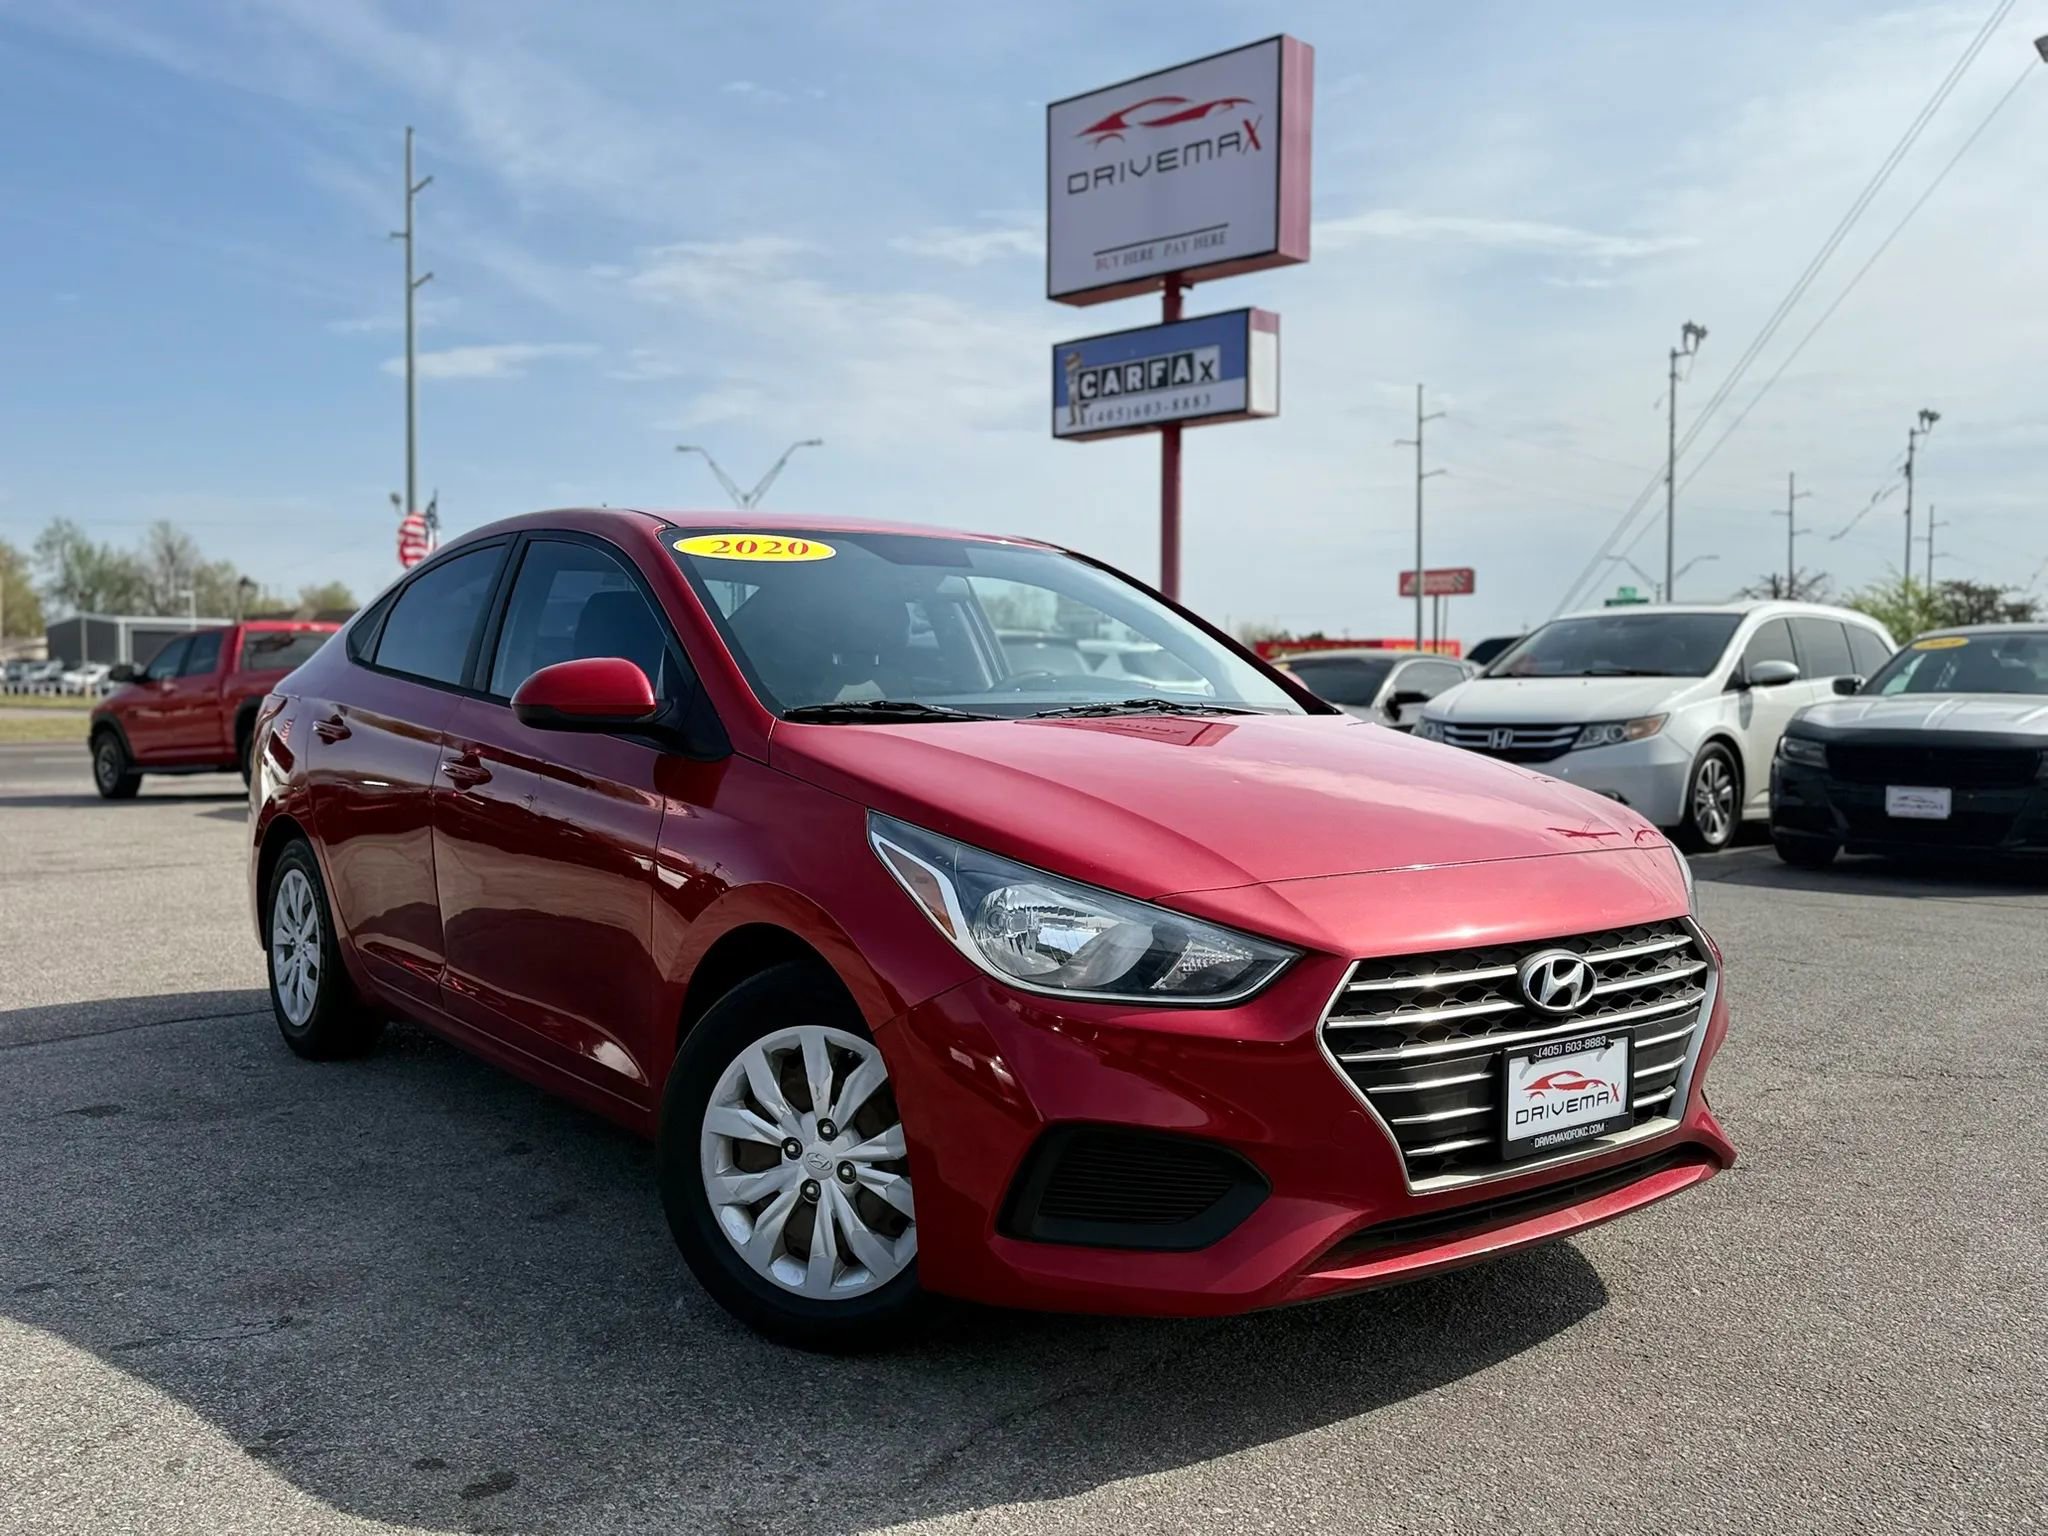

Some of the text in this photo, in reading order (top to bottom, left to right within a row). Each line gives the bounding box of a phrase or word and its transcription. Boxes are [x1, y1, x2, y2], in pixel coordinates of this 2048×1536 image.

[1067, 115, 1262, 195] DRIVEMAX
[711, 540, 809, 556] 2020
[1538, 1036, 1606, 1058] (405) 603-8883
[1515, 1082, 1620, 1125] DRIVEMAX
